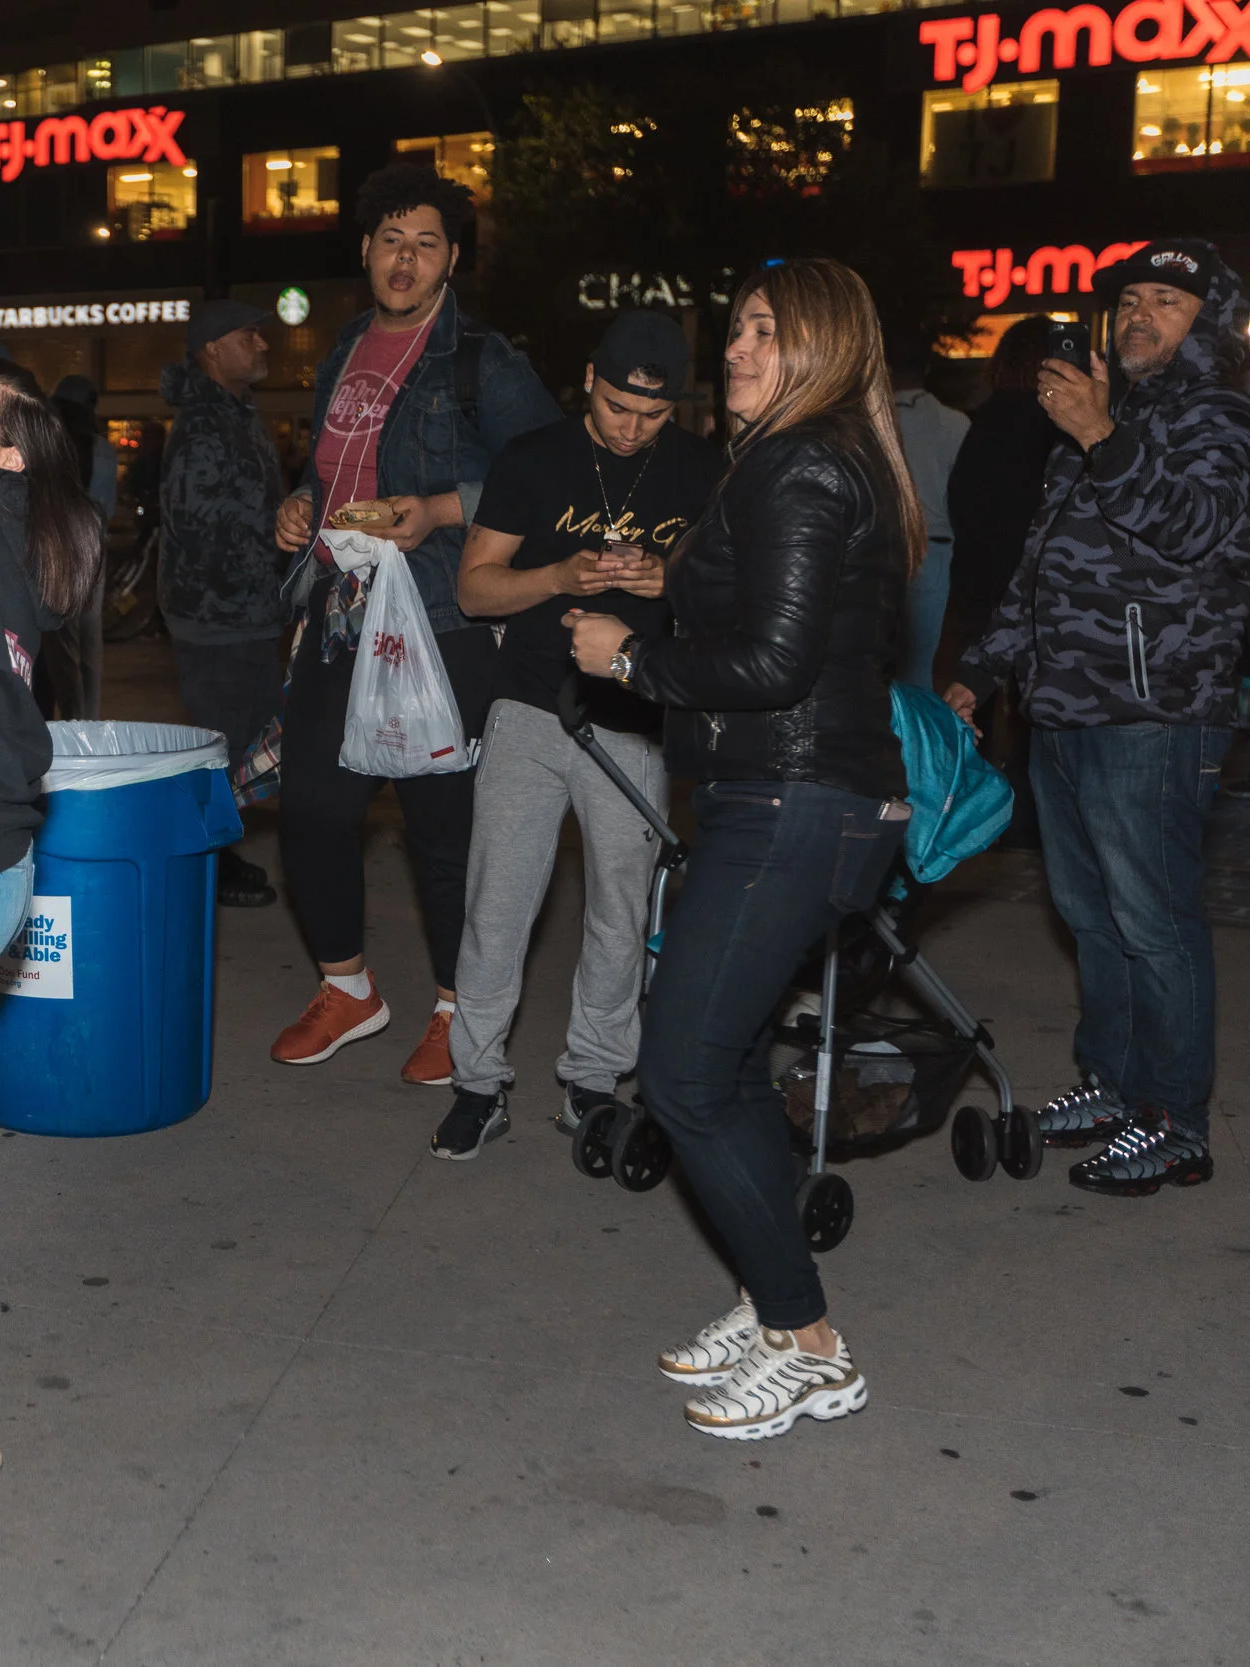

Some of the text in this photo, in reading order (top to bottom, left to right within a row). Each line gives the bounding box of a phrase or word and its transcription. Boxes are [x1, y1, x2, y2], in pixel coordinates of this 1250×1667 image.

[106, 300, 190, 324] COFFEE
[24, 914, 54, 932] ady
[22, 947, 61, 962] Able
[17, 969, 40, 980] Fund
